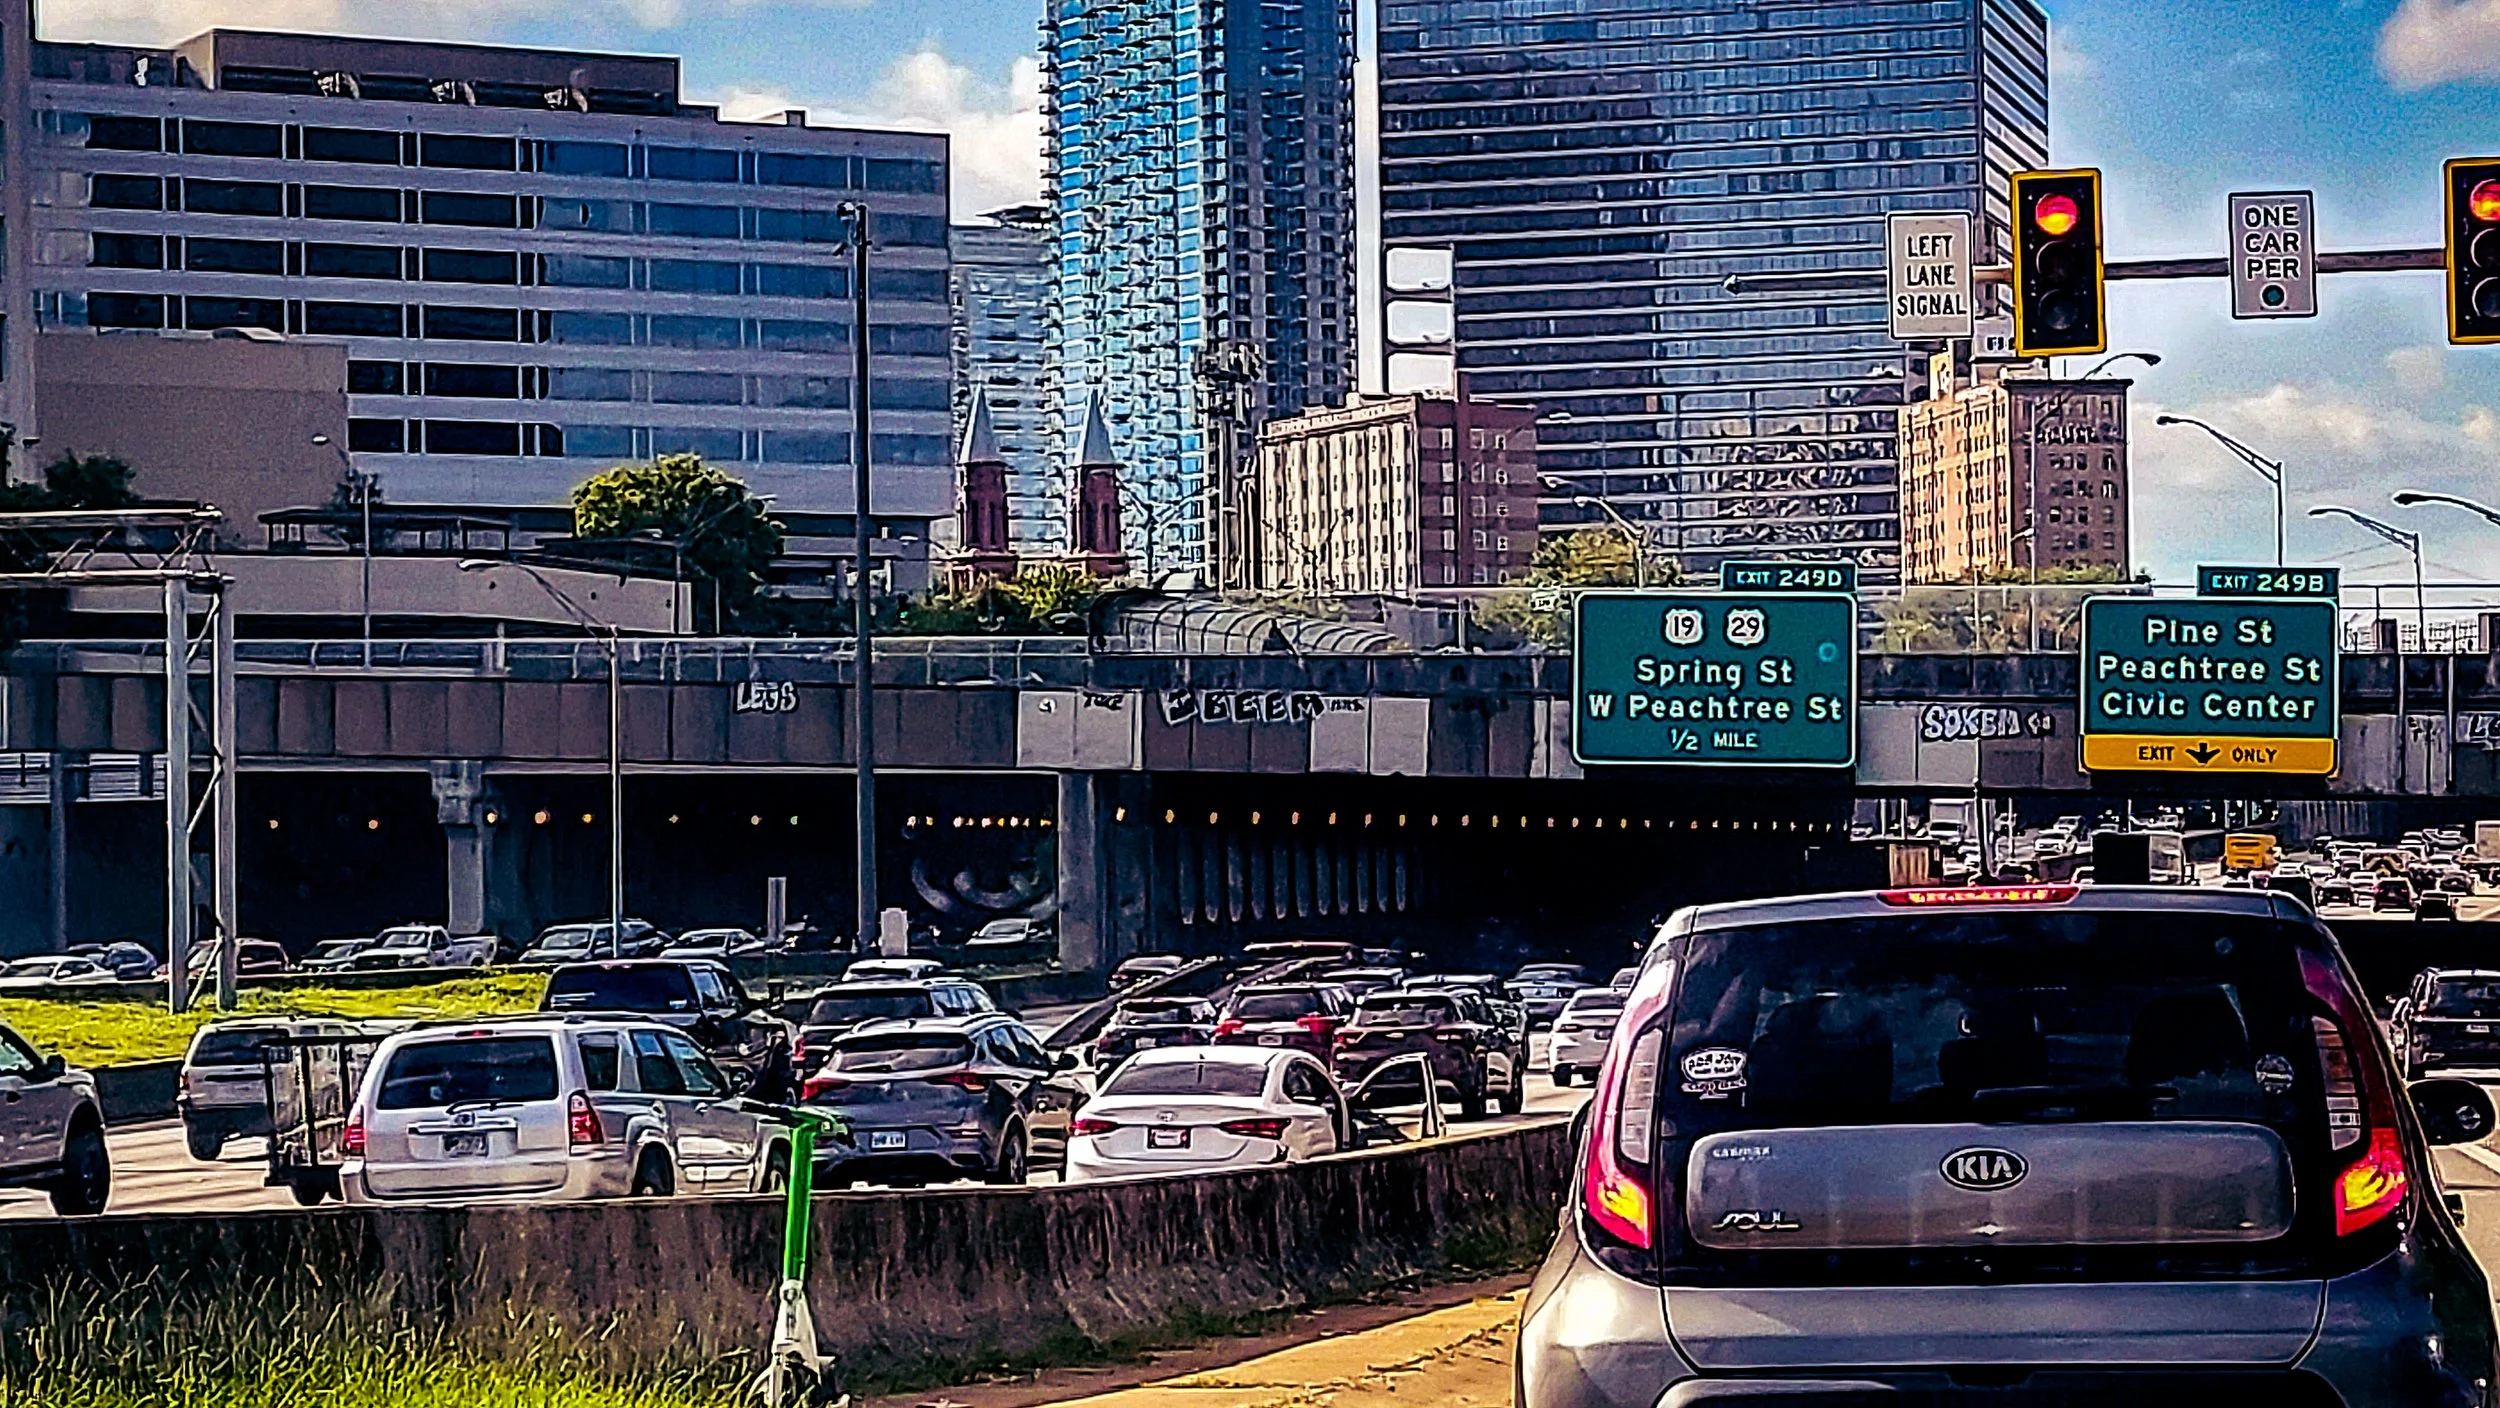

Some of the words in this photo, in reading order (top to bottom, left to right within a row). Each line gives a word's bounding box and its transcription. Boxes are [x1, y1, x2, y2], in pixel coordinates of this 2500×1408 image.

[2244, 205, 2299, 228] ONE
[1906, 234, 1953, 258] LEFT
[2244, 231, 2299, 254] CAR
[1905, 264, 1956, 287] LANE
[2247, 258, 2300, 280] PER
[1896, 293, 1967, 318] SIGNAL
[1736, 570, 1771, 586] EXIT
[1778, 569, 1843, 588] 249D
[2211, 574, 2247, 590] EXIT
[2256, 573, 2325, 593] 249B
[1672, 615, 1695, 638] 19
[1730, 615, 1762, 638] 29
[2147, 619, 2219, 645] Pine
[2237, 619, 2274, 645] St
[1636, 658, 1743, 689] Spring
[1759, 658, 1795, 685] St
[2098, 655, 2266, 682] Peachtree
[2284, 656, 2321, 682] St
[1588, 694, 1613, 718] W
[1629, 694, 1791, 720] Peachtree
[1808, 696, 1843, 720] St
[2102, 690, 2186, 718] Civic
[2204, 692, 2315, 720] Center
[1713, 731, 1760, 749] MILE
[2138, 745, 2175, 762] EXIT
[2231, 745, 2279, 764] ONLY
[1956, 1155, 2013, 1180] KIA
[1711, 1211, 1800, 1230] SOUL
